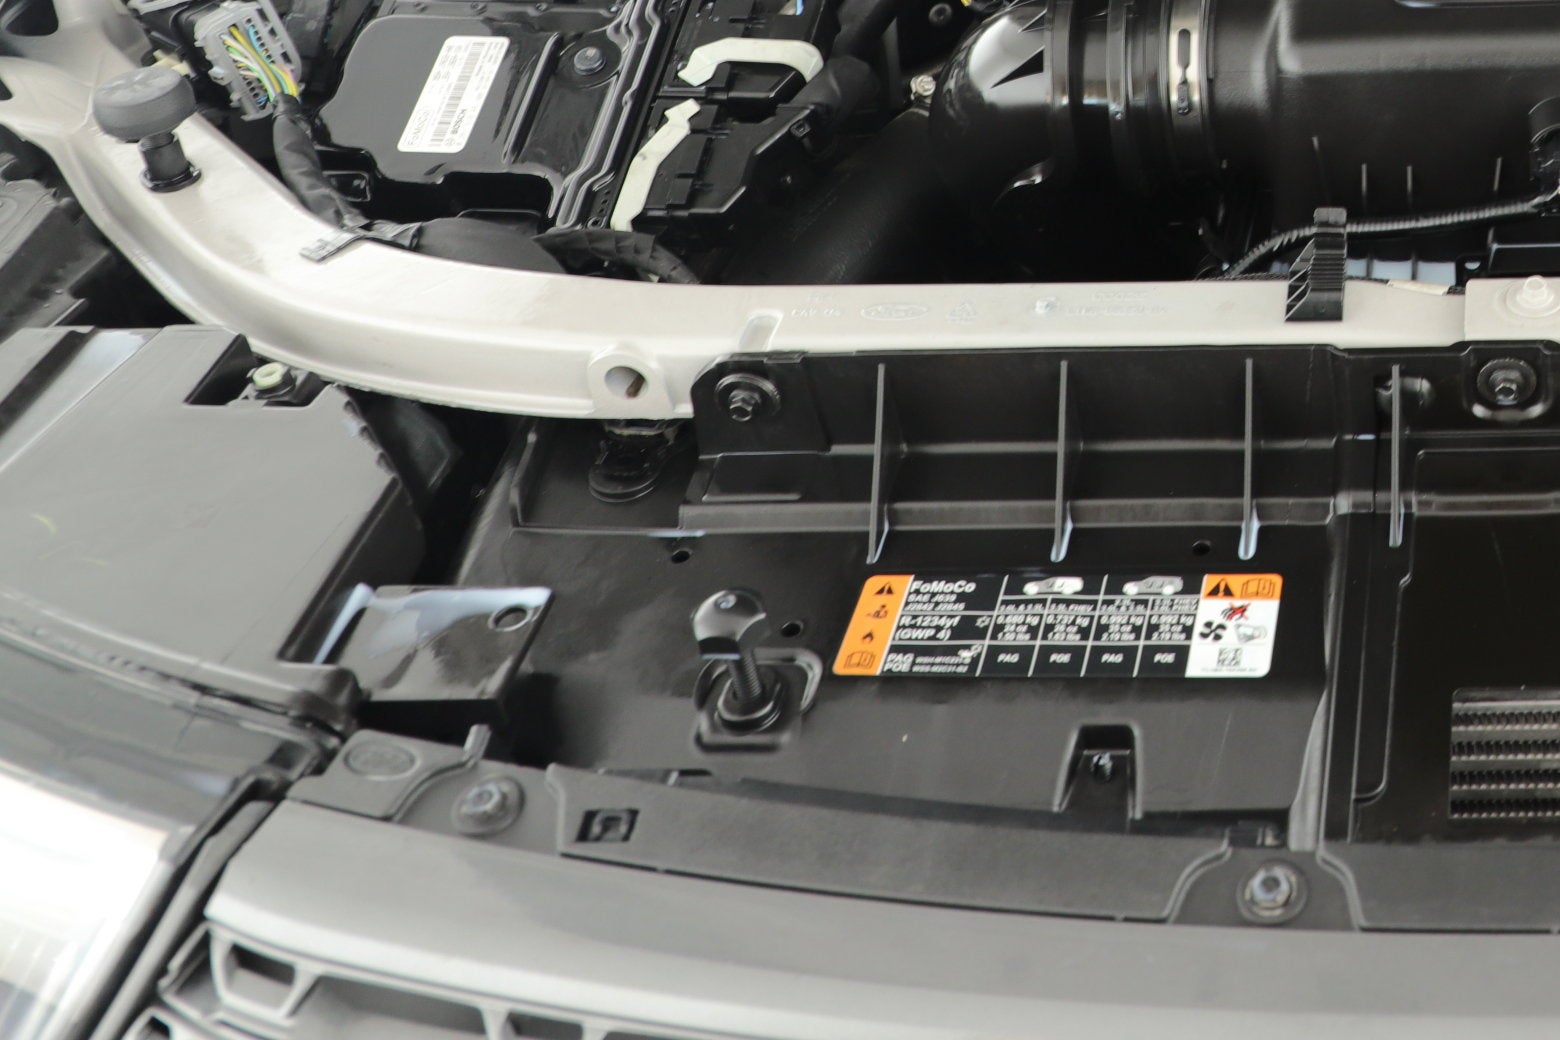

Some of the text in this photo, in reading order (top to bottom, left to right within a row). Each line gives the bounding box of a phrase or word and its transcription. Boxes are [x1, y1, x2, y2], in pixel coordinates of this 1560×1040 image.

[450, 109, 467, 135] BOSCH
[910, 580, 977, 593] FoMoCo
[907, 593, 931, 602] SAE
[899, 615, 961, 629] R-1234yf
[1025, 615, 1040, 626] kg
[1075, 615, 1091, 627] kg
[1129, 615, 1144, 626] kg
[1179, 615, 1195, 626] kg
[894, 628, 952, 641] (GWP 4)
[886, 652, 915, 662] PAG
[997, 653, 1020, 663] PAG
[1049, 653, 1072, 663] POE
[1101, 653, 1124, 663] PAG
[1153, 653, 1176, 663] POE
[883, 661, 913, 673] POE
